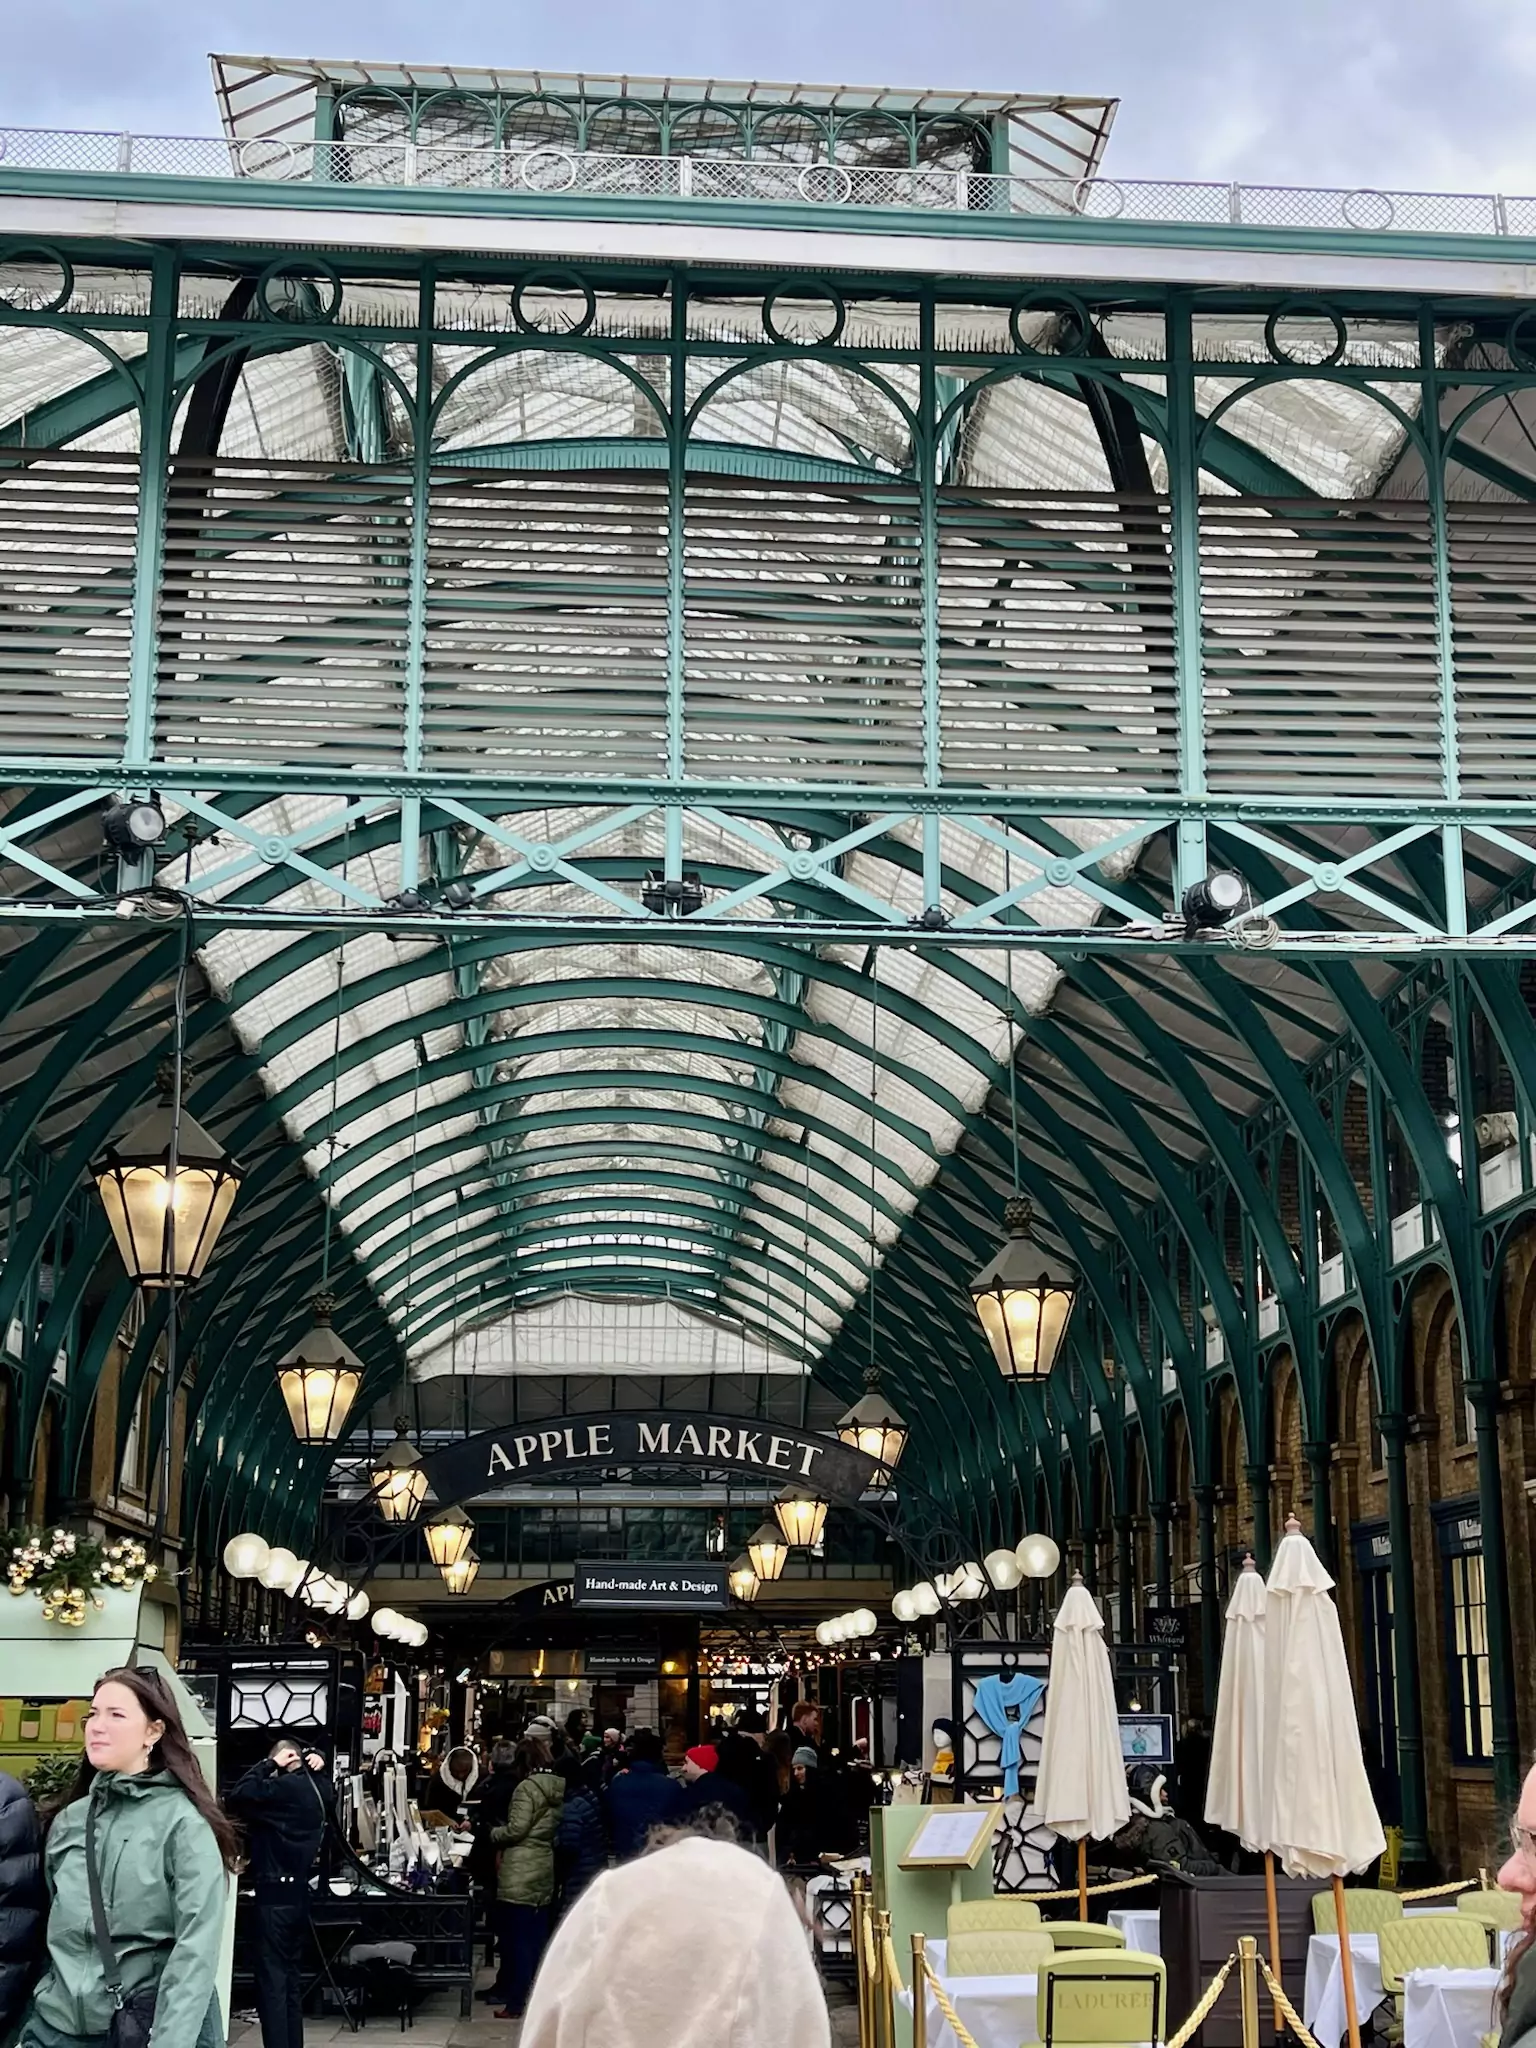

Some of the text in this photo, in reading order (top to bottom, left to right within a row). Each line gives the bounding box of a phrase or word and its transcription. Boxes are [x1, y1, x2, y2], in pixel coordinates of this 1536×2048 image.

[487, 1422, 823, 1477] APPLE MARKET
[585, 1577, 718, 1595] Hand-made Art & Design
